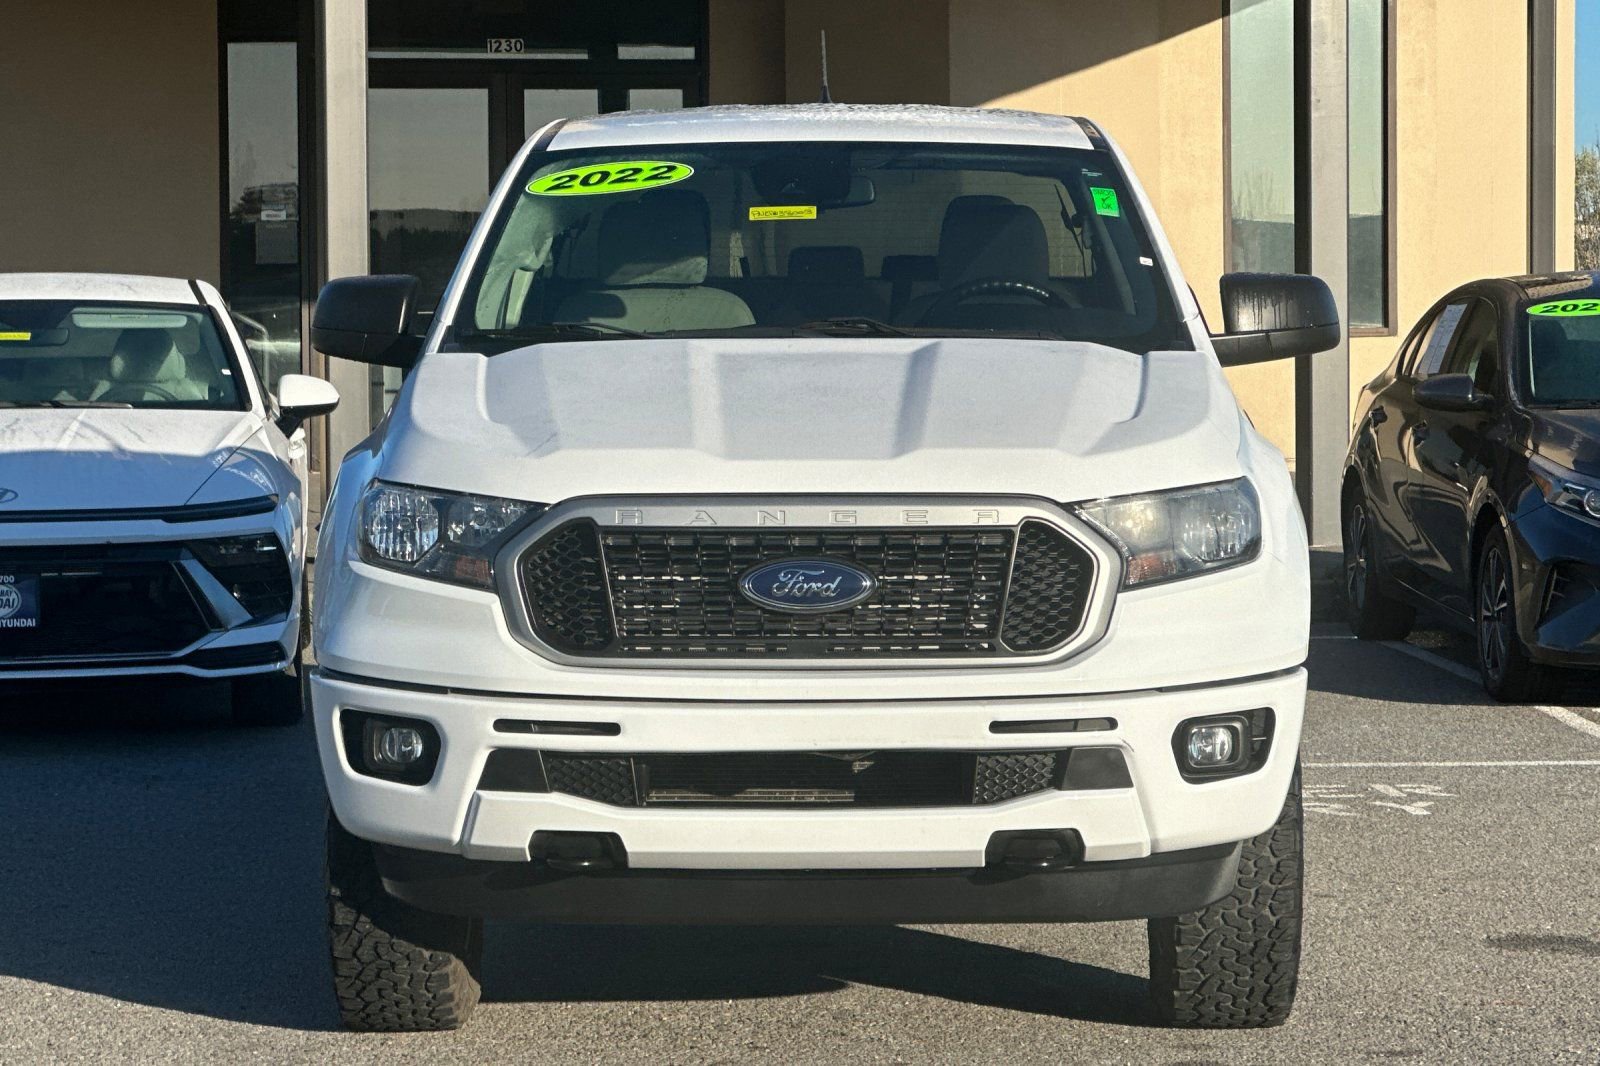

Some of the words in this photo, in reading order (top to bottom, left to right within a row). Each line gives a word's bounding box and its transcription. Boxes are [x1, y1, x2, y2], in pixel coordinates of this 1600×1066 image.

[488, 39, 523, 53] 1230
[543, 164, 678, 193] 2022
[615, 509, 1000, 525] RANGER
[771, 568, 842, 597] Ford
[0, 618, 36, 628] YUNDAI
